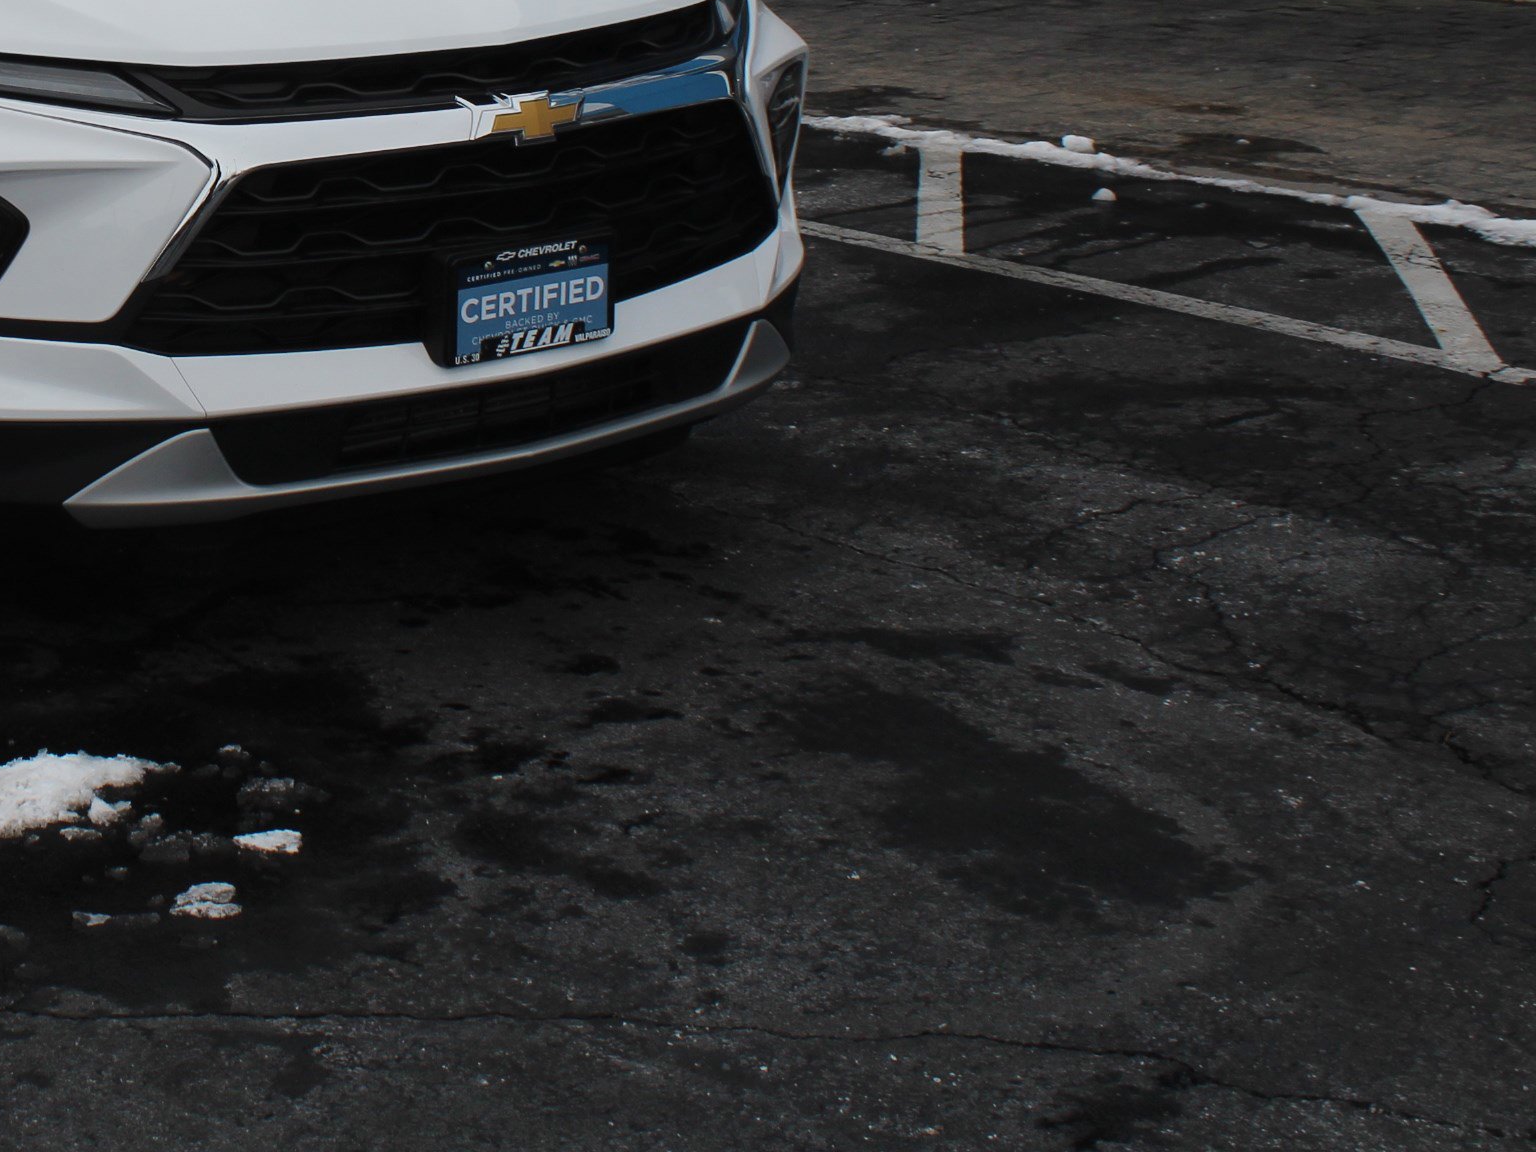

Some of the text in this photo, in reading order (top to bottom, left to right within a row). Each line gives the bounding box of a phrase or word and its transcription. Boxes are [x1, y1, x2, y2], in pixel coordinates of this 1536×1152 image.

[517, 240, 578, 259] CHEVROLET
[466, 271, 502, 283] CERTIFIED
[460, 275, 605, 324] CERTIFIED
[505, 314, 544, 329] BACKED
[547, 311, 560, 322] BY
[510, 322, 575, 351] TEAM
[574, 327, 611, 343] VALPARAISO
[454, 352, 481, 365] U.S. 30
